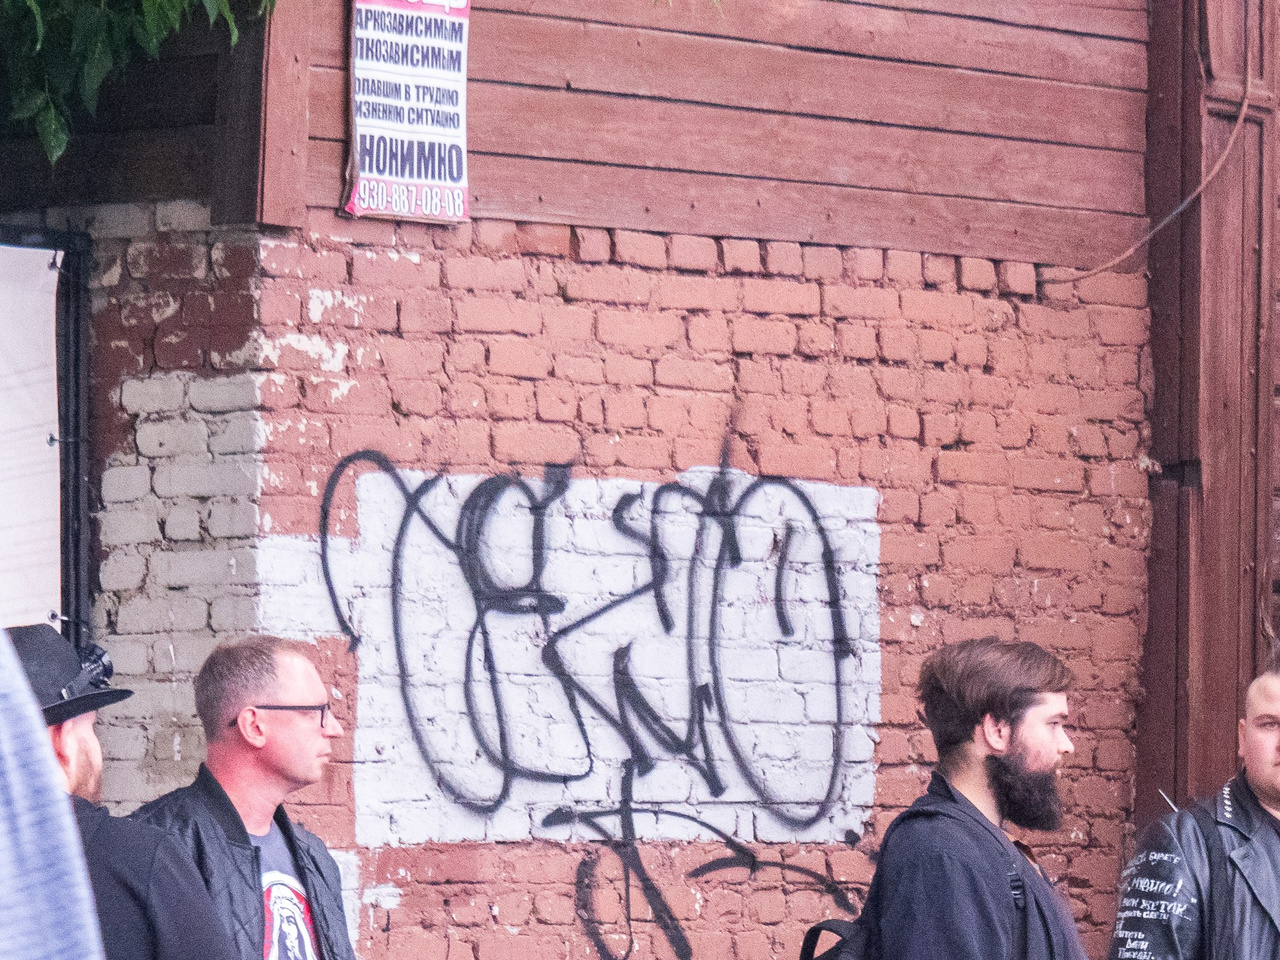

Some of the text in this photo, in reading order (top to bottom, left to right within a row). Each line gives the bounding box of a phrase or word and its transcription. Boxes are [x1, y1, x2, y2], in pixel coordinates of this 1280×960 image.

[404, 83, 411, 102] В
[407, 106, 460, 130] СИТУАЦИЮ
[359, 134, 463, 183] НОНИМНО
